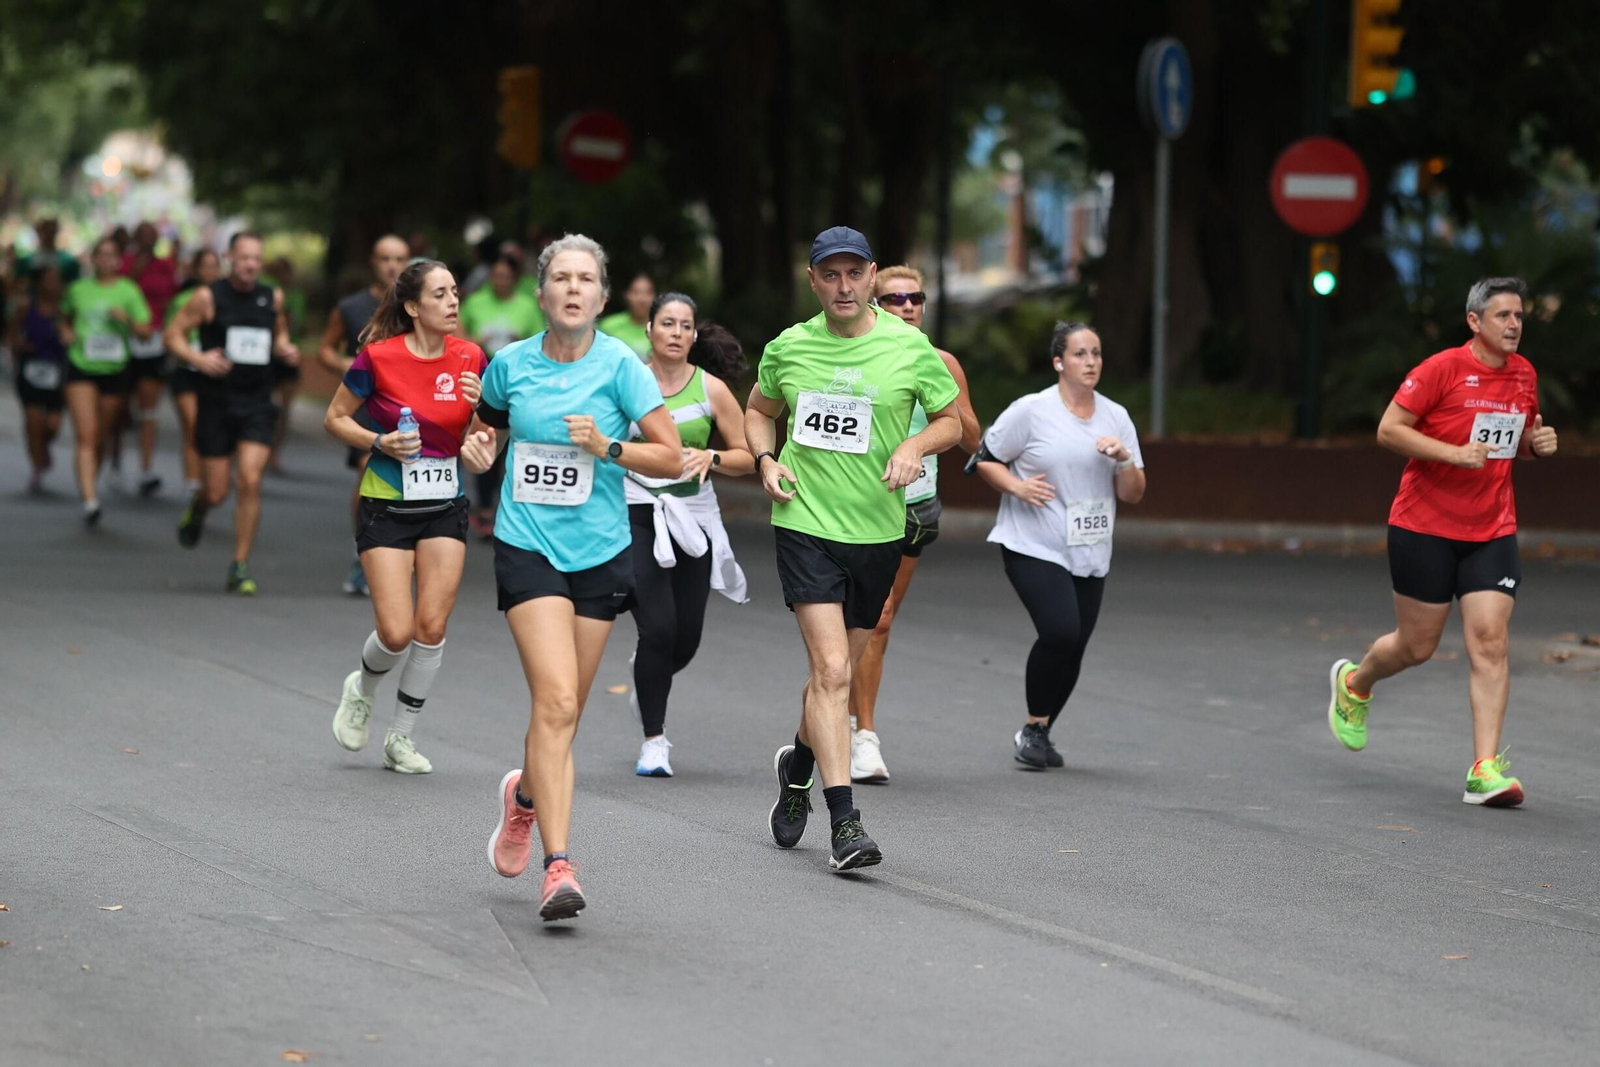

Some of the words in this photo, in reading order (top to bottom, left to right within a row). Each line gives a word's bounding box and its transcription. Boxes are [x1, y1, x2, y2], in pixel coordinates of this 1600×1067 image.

[804, 412, 858, 436] 462
[1477, 429, 1514, 445] 311
[409, 468, 452, 483] 1178
[524, 464, 578, 487] 959
[1073, 515, 1108, 530] 1528
